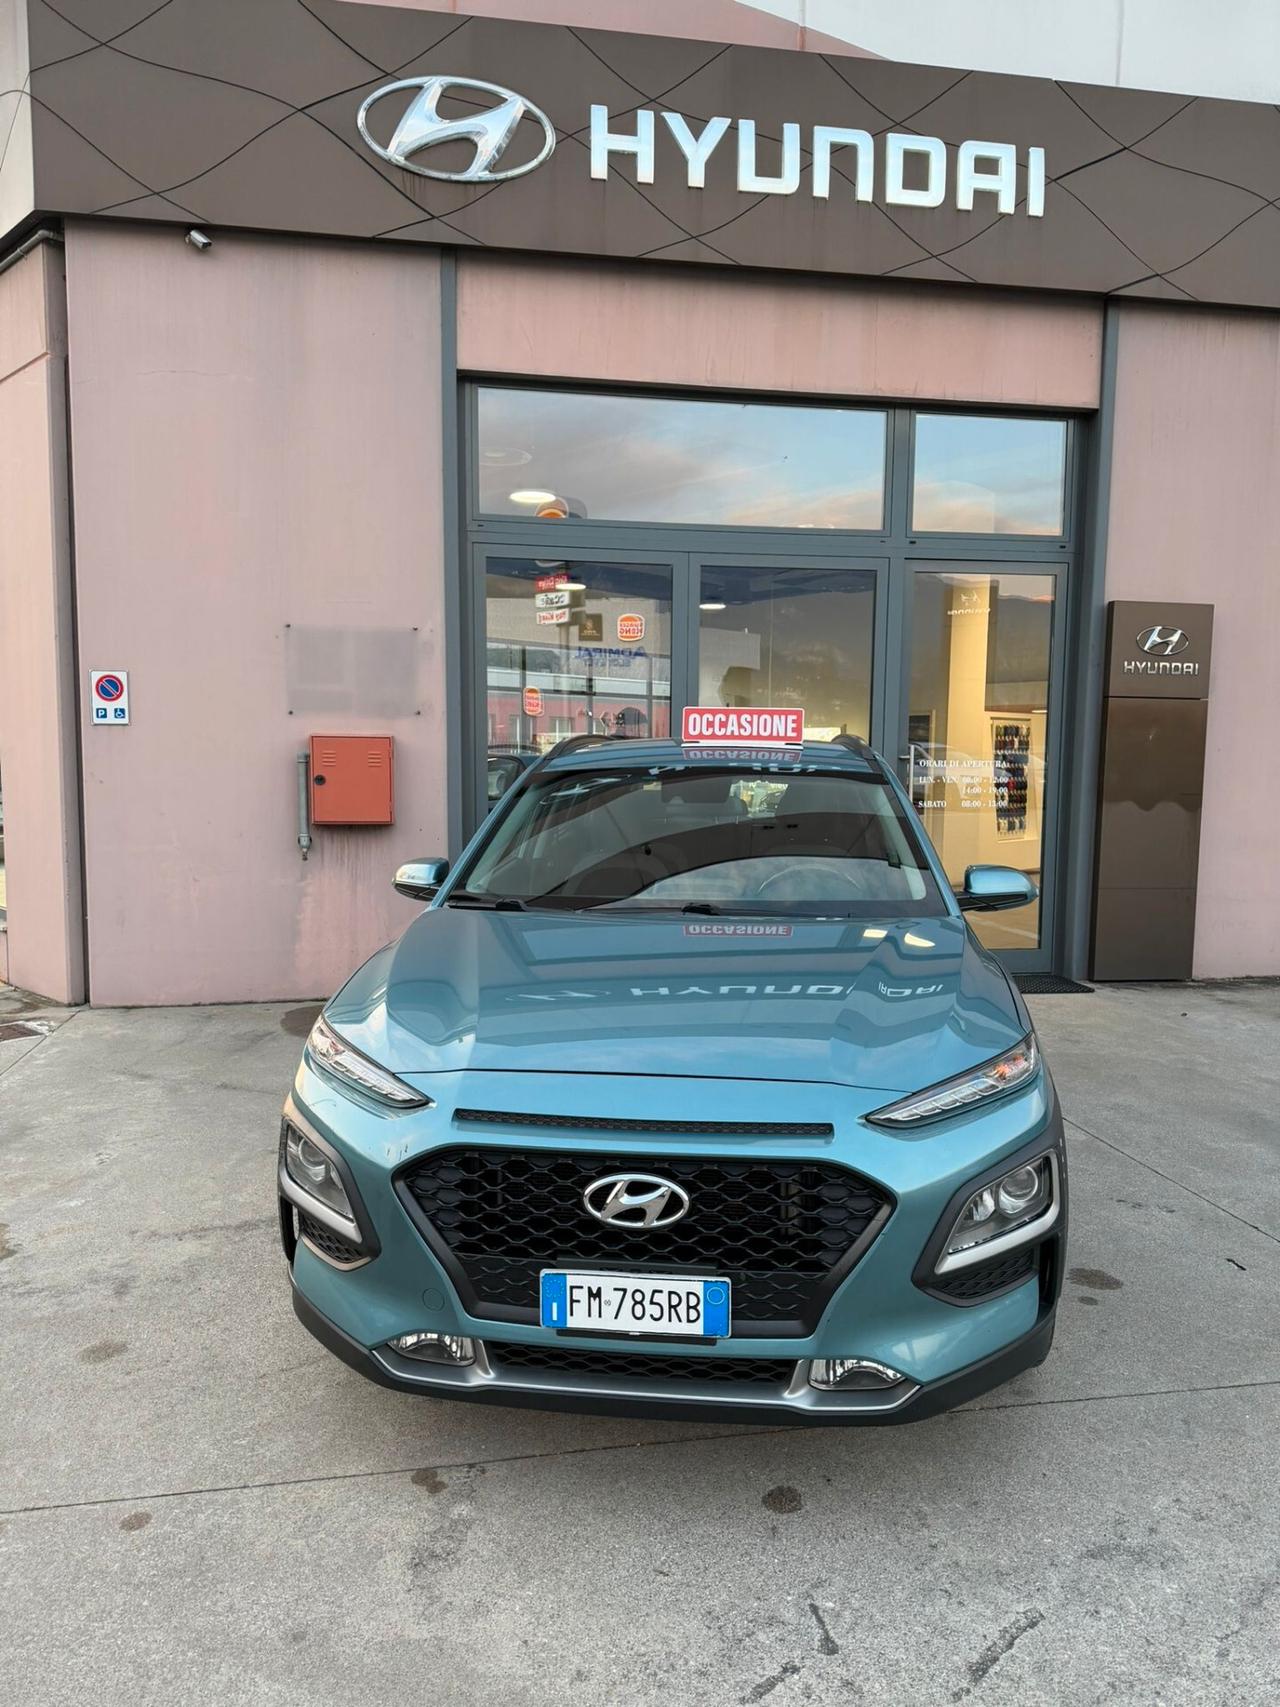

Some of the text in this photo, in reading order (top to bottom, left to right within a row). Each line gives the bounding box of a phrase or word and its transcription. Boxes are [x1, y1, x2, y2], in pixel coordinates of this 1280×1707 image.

[589, 104, 1045, 217] HYUNDAI
[1123, 660, 1199, 675] HYUNDAI
[688, 713, 797, 737] OCCASIONE
[919, 759, 1006, 769] ORARI DI APERTURA
[918, 800, 946, 808] SABATO
[613, 1287, 701, 1324] 785RB
